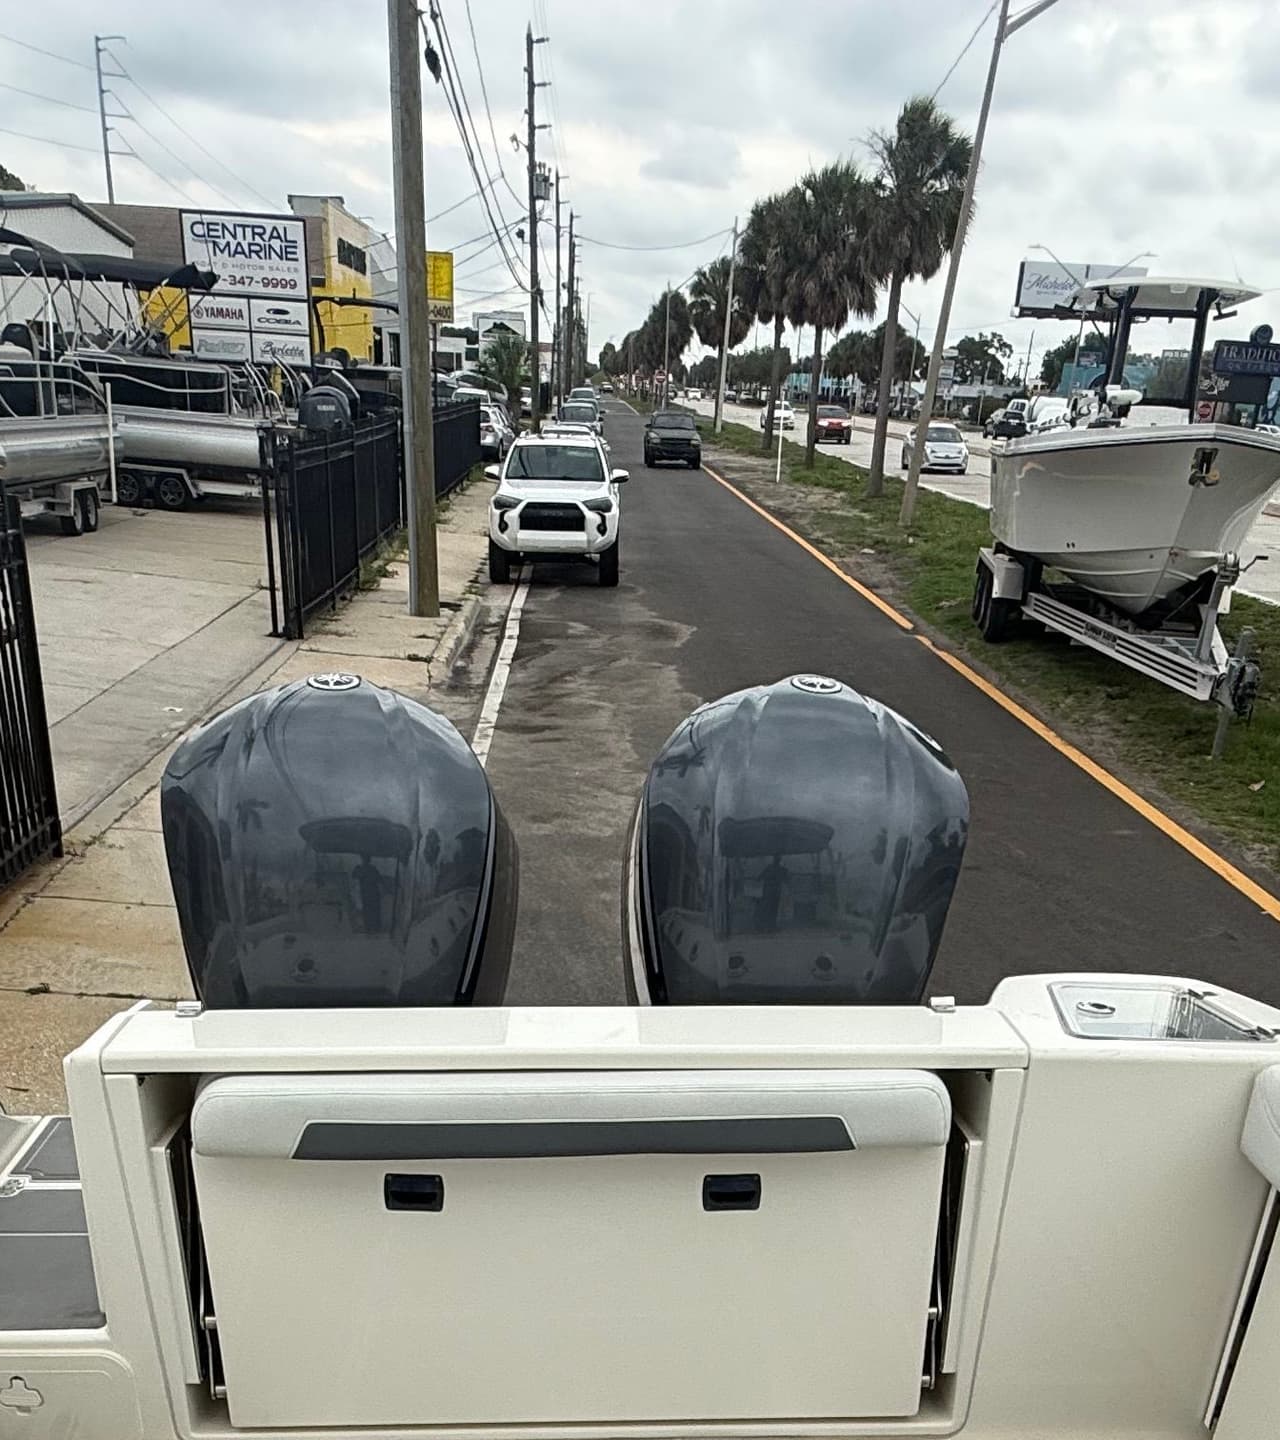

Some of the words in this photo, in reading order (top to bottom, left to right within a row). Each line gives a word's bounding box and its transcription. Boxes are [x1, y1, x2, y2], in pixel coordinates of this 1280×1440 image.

[190, 221, 298, 244] CENTRAL
[211, 240, 299, 262] MARINE
[203, 306, 245, 321] YAMAHA
[256, 316, 302, 326] COBIA
